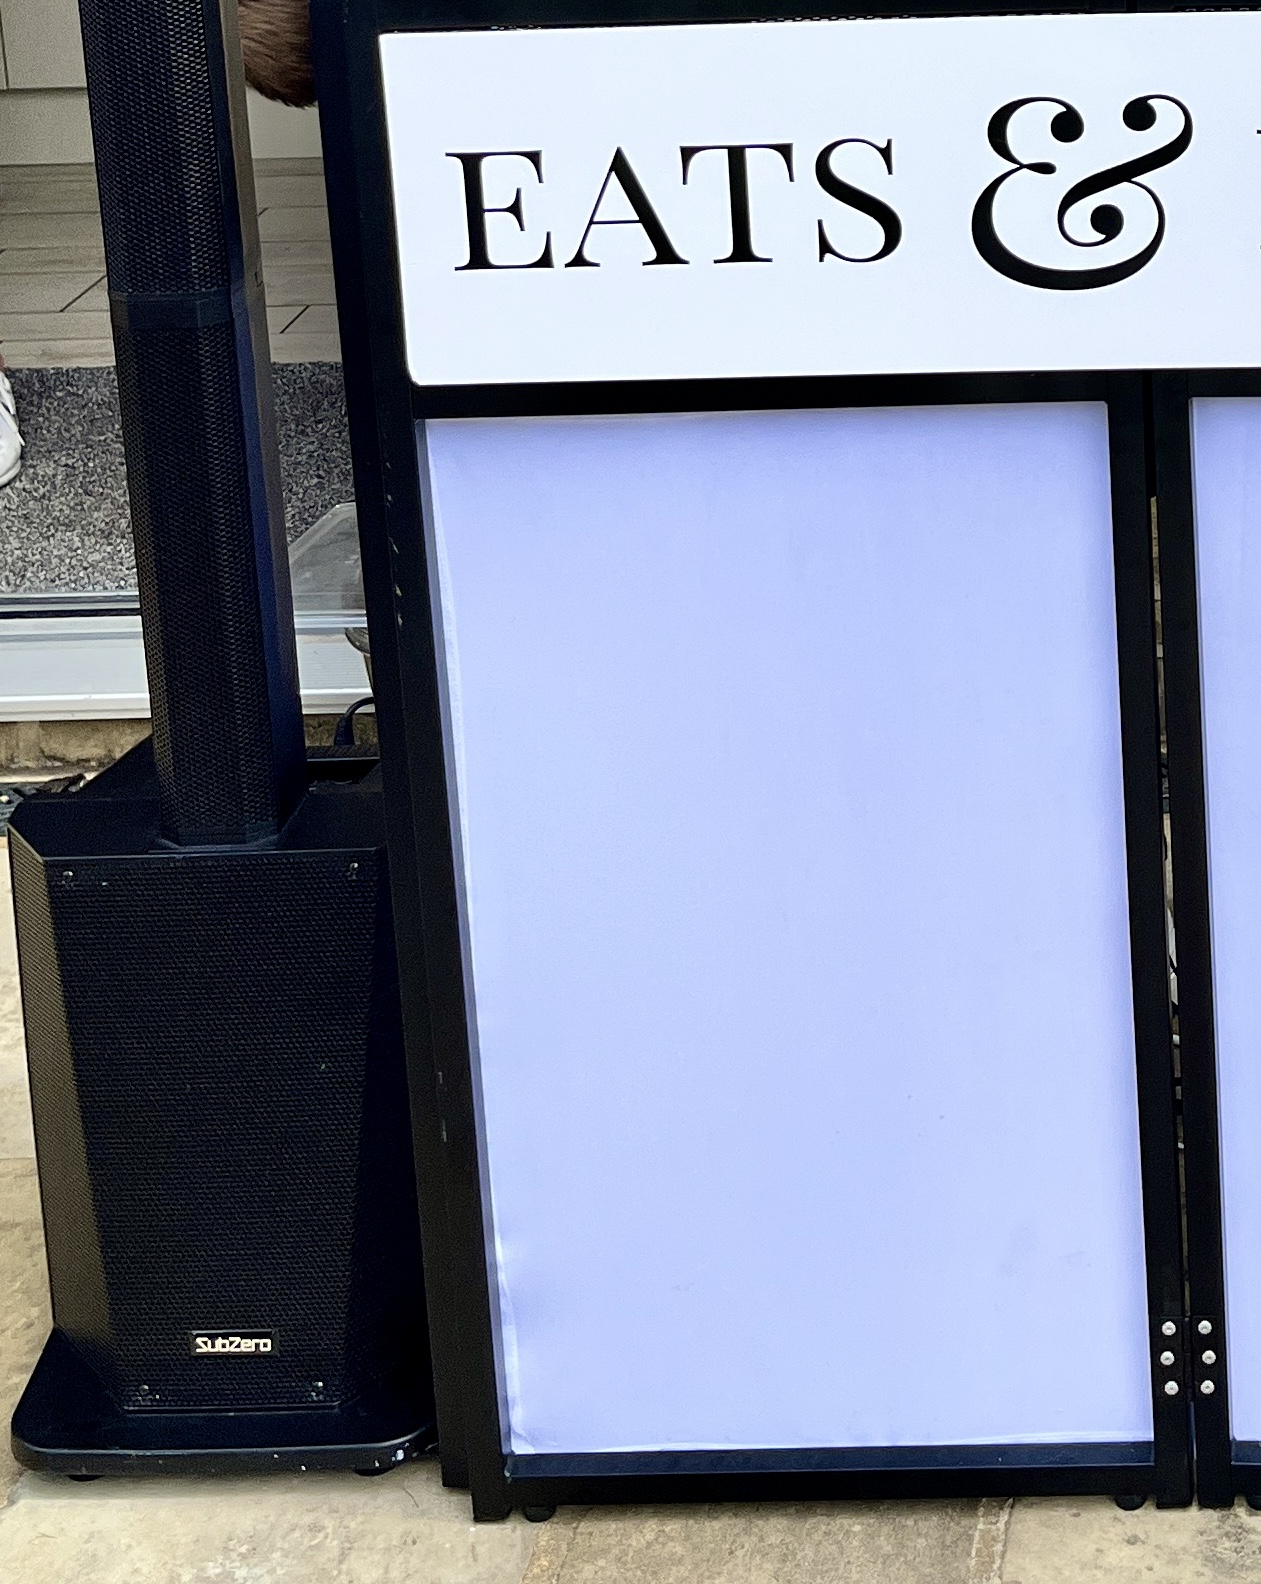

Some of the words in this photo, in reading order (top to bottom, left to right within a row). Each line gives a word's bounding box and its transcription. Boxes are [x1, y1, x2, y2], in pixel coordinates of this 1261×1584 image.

[444, 138, 902, 272] EATS
[971, 94, 1194, 291] &
[194, 1336, 272, 1353] SubZero
